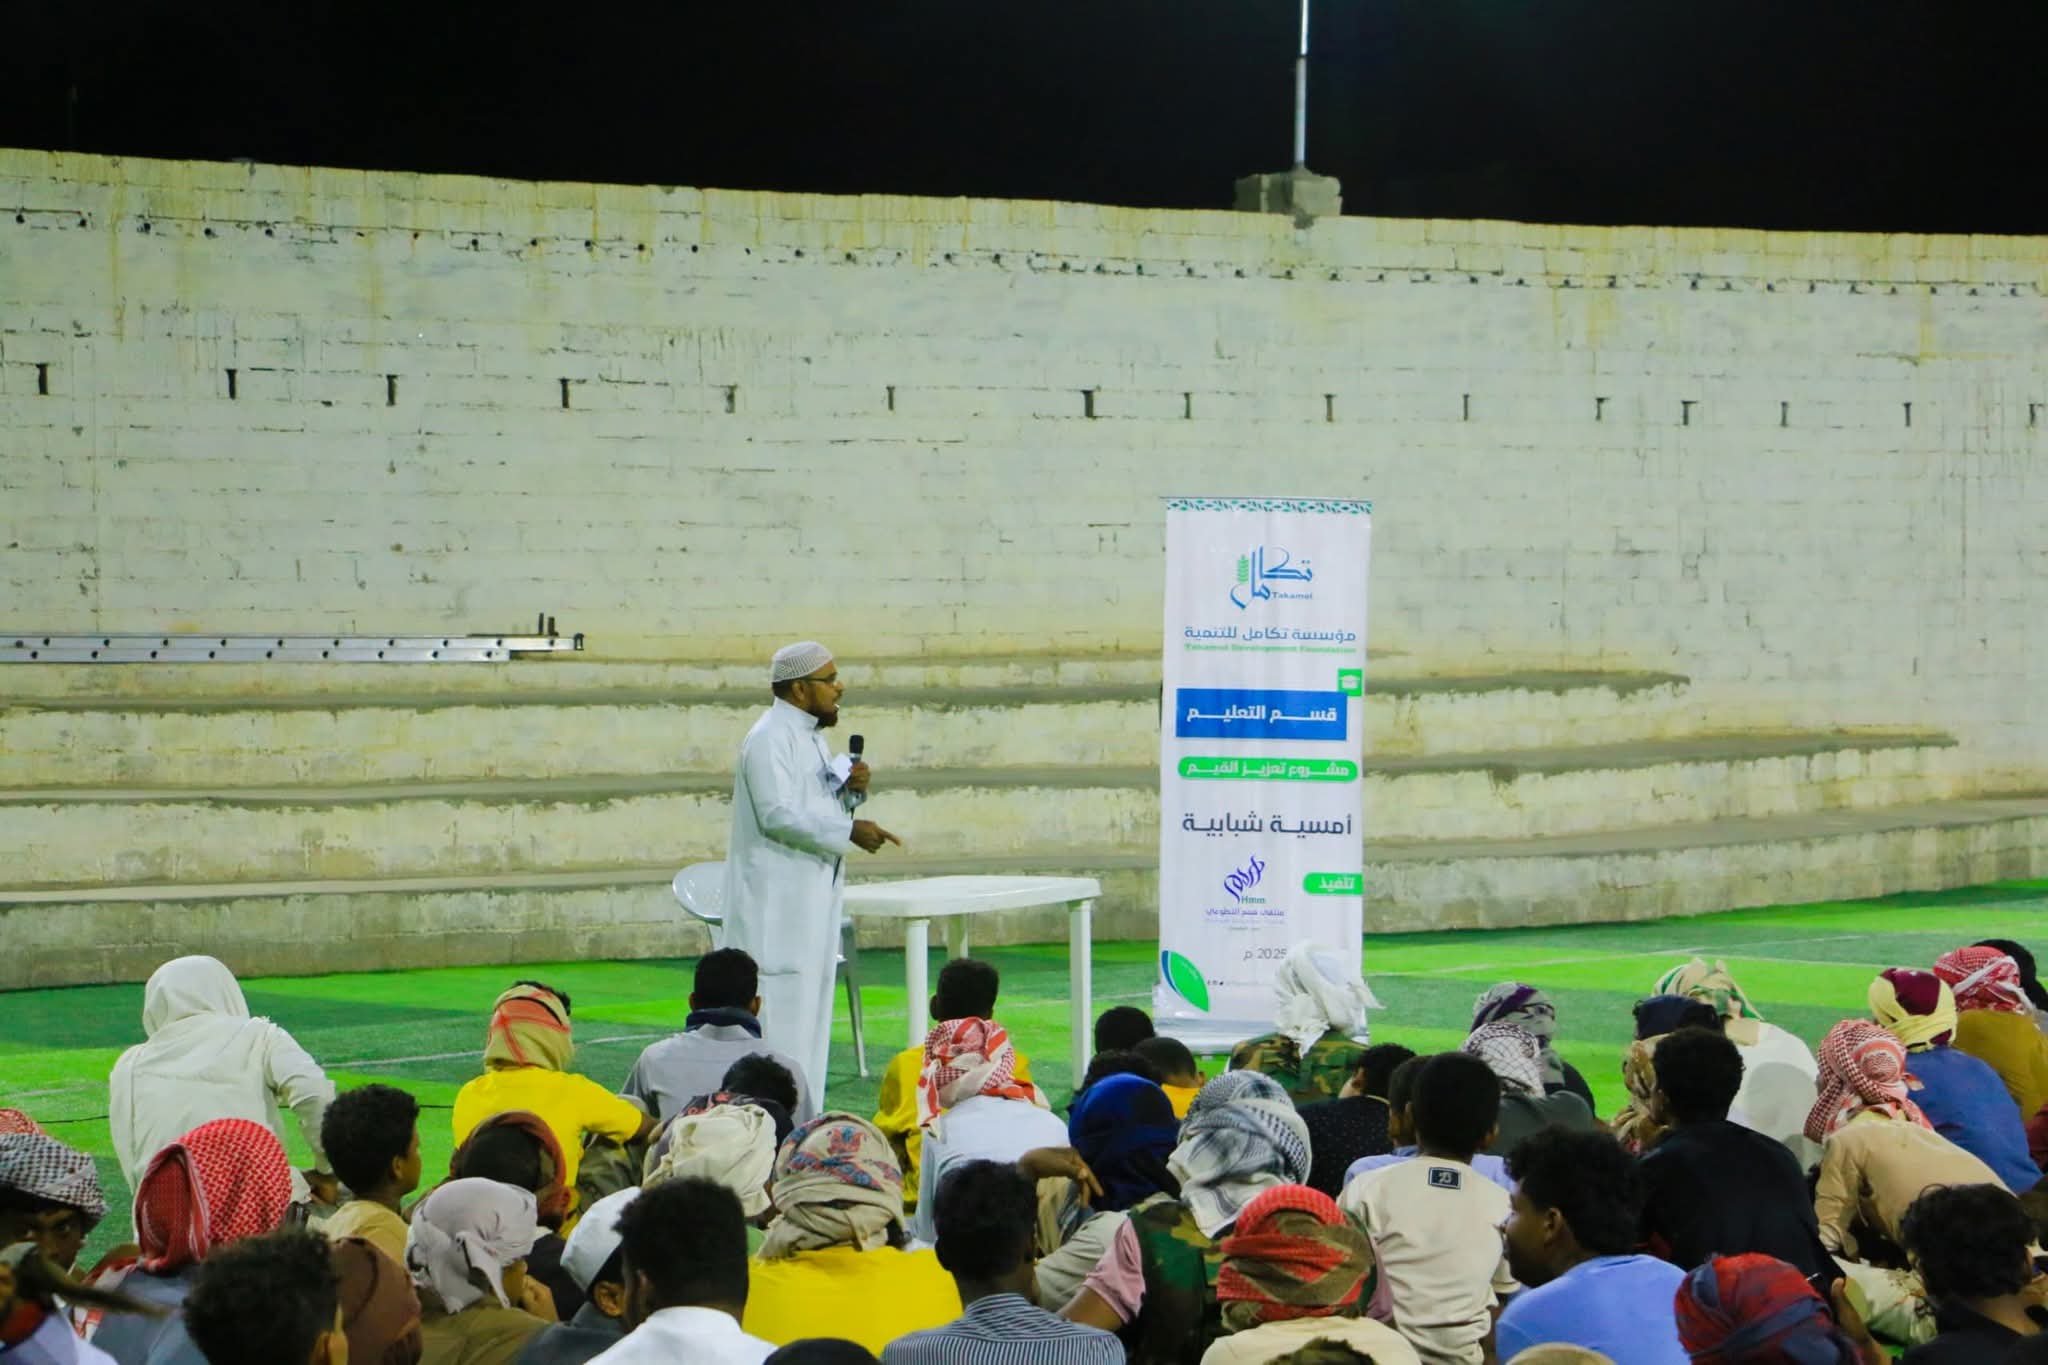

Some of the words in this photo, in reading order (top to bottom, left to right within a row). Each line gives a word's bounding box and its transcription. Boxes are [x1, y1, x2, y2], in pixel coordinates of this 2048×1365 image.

[1184, 625, 1237, 641] للتنمية
[1242, 626, 1288, 641] تكامل
[1291, 628, 1357, 644] مؤسسة
[1186, 703, 1266, 722] التعليم
[1269, 706, 1338, 724] قسم
[1186, 760, 1239, 775] القيم
[1241, 760, 1286, 776] تعزيز
[1288, 762, 1350, 777] مشروع
[1182, 810, 1264, 838] شبابية
[1269, 813, 1352, 839] أمسية
[1318, 876, 1356, 892] تنفيذ
[1257, 947, 1288, 960] 2025
